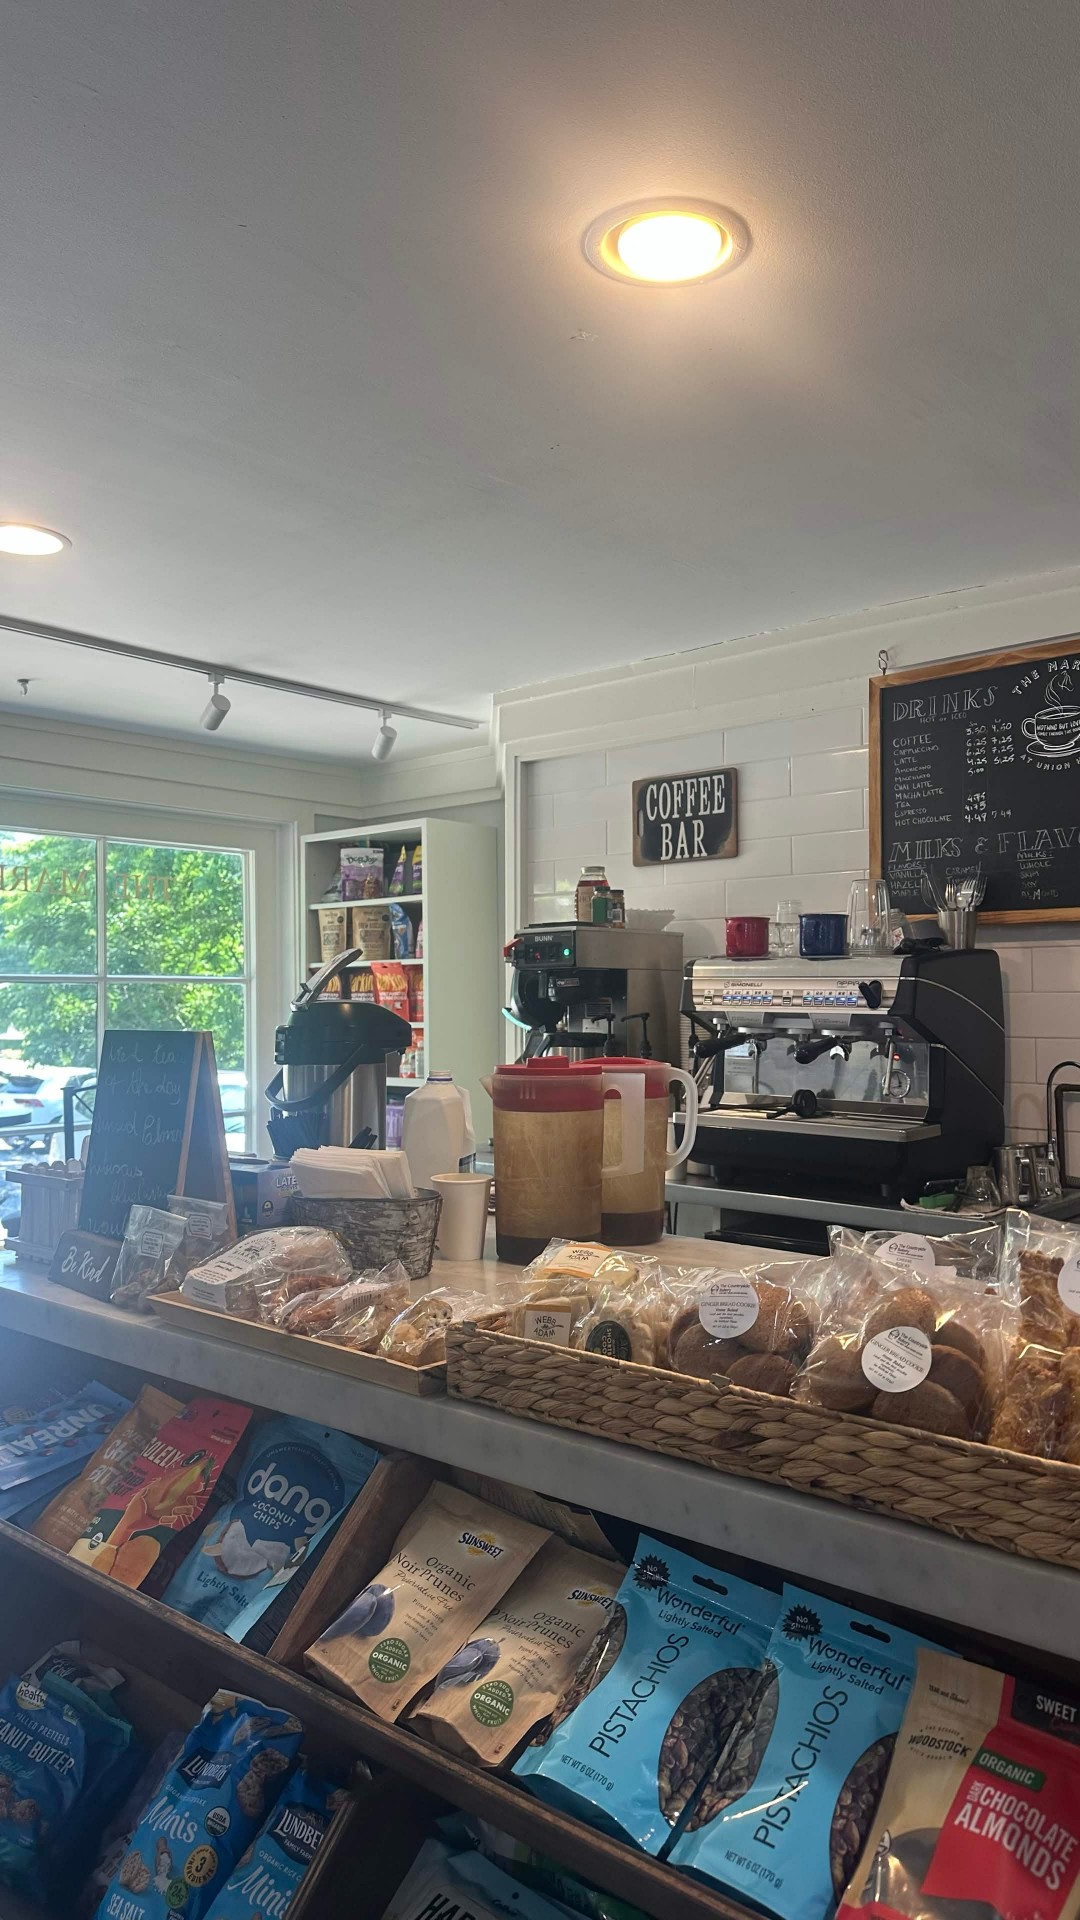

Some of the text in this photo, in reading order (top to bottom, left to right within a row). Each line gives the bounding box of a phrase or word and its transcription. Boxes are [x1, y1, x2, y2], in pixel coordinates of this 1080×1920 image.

[1012, 669, 1040, 694] THE
[893, 686, 998, 721] DRINKS
[893, 733, 932, 748] COFFEE
[893, 744, 939, 756] CAPPUCCINO
[966, 737, 987, 747] 6.25
[966, 748, 986, 757] 6.25
[894, 756, 917, 766] LATTE
[966, 757, 987, 766] 4.25
[1036, 762, 1071, 771] UNION
[646, 774, 725, 821] COFFEE
[894, 781, 933, 791] CHAI LATTE
[922, 787, 944, 797] LATTE
[895, 801, 911, 809] TEA
[895, 808, 927, 818] ESPRESSO
[895, 814, 952, 827] HOT CHOCOLATE
[660, 819, 708, 861] BAR
[888, 837, 963, 862] MILKS
[997, 827, 1080, 853] FLAV
[1020, 861, 1052, 869] WHOLE
[127, 1068, 153, 1096] the
[156, 1077, 183, 1105] day
[276, 1176, 298, 1187] LATE
[61, 1247, 111, 1283] Be Kind
[533, 1327, 556, 1338] ADAM
[535, 1316, 557, 1325] WEBB
[0, 1403, 114, 1459] UNREAL
[247, 1462, 331, 1535] dang
[252, 1500, 297, 1528] COCONUT
[253, 1510, 281, 1532] CHIPS
[457, 1532, 504, 1560] SUNSWEET
[426, 1555, 476, 1592] Organic
[646, 1563, 658, 1573] No
[197, 1570, 229, 1595] Lightly
[420, 1567, 465, 1602] Prunes
[436, 1594, 455, 1612] Free
[567, 1588, 613, 1609] SUNSWEET
[426, 1605, 445, 1624] Prunes
[656, 1588, 742, 1636] Wonderful
[657, 1609, 722, 1639] Lightly Salted
[796, 1614, 809, 1625] No
[525, 1616, 575, 1649] Prunes
[533, 1611, 586, 1639] Organic
[372, 1651, 408, 1671] ORGANIC
[379, 1639, 409, 1659] ZERO SUGAR
[542, 1640, 562, 1658] Free
[370, 1663, 386, 1682] WHOLE
[385, 1673, 400, 1682] FRUIT
[807, 1637, 906, 1691] Wonderful
[810, 1660, 885, 1696] Lightly Salted
[474, 1691, 510, 1716] ORGANIC
[482, 1680, 513, 1702] ZERO SUGAR
[588, 1632, 690, 1758] PISTACHIOS
[471, 1704, 487, 1725] WHOLE
[487, 1716, 502, 1726] FRUIT
[1036, 1695, 1077, 1722] SWEET
[16, 1712, 71, 1746] FILLED PRETZELS
[27, 1740, 75, 1776] BUTTER
[908, 1733, 970, 1759] WOODSTOCK
[560, 1754, 572, 1765] NET
[570, 1758, 580, 1769] WT
[585, 1766, 595, 1778] OZ
[753, 1685, 849, 1850] PISTACHIOS
[978, 1751, 1036, 1785] ORGANIC
[966, 1779, 986, 1803] DARK
[140, 1795, 198, 1844] Minis
[211, 1810, 227, 1825] USDA
[979, 1785, 1079, 1863] CHOCOLATE
[283, 1838, 300, 1853] FAMILY
[954, 1802, 1067, 1891] ALMONDS
[195, 1853, 207, 1873] 3
[258, 1849, 298, 1880] ORGANIC RICE
[724, 1850, 738, 1864] NET
[735, 1855, 747, 1869] WT
[750, 1862, 761, 1876] OZ
[106, 1893, 146, 1920] SEA SALT
